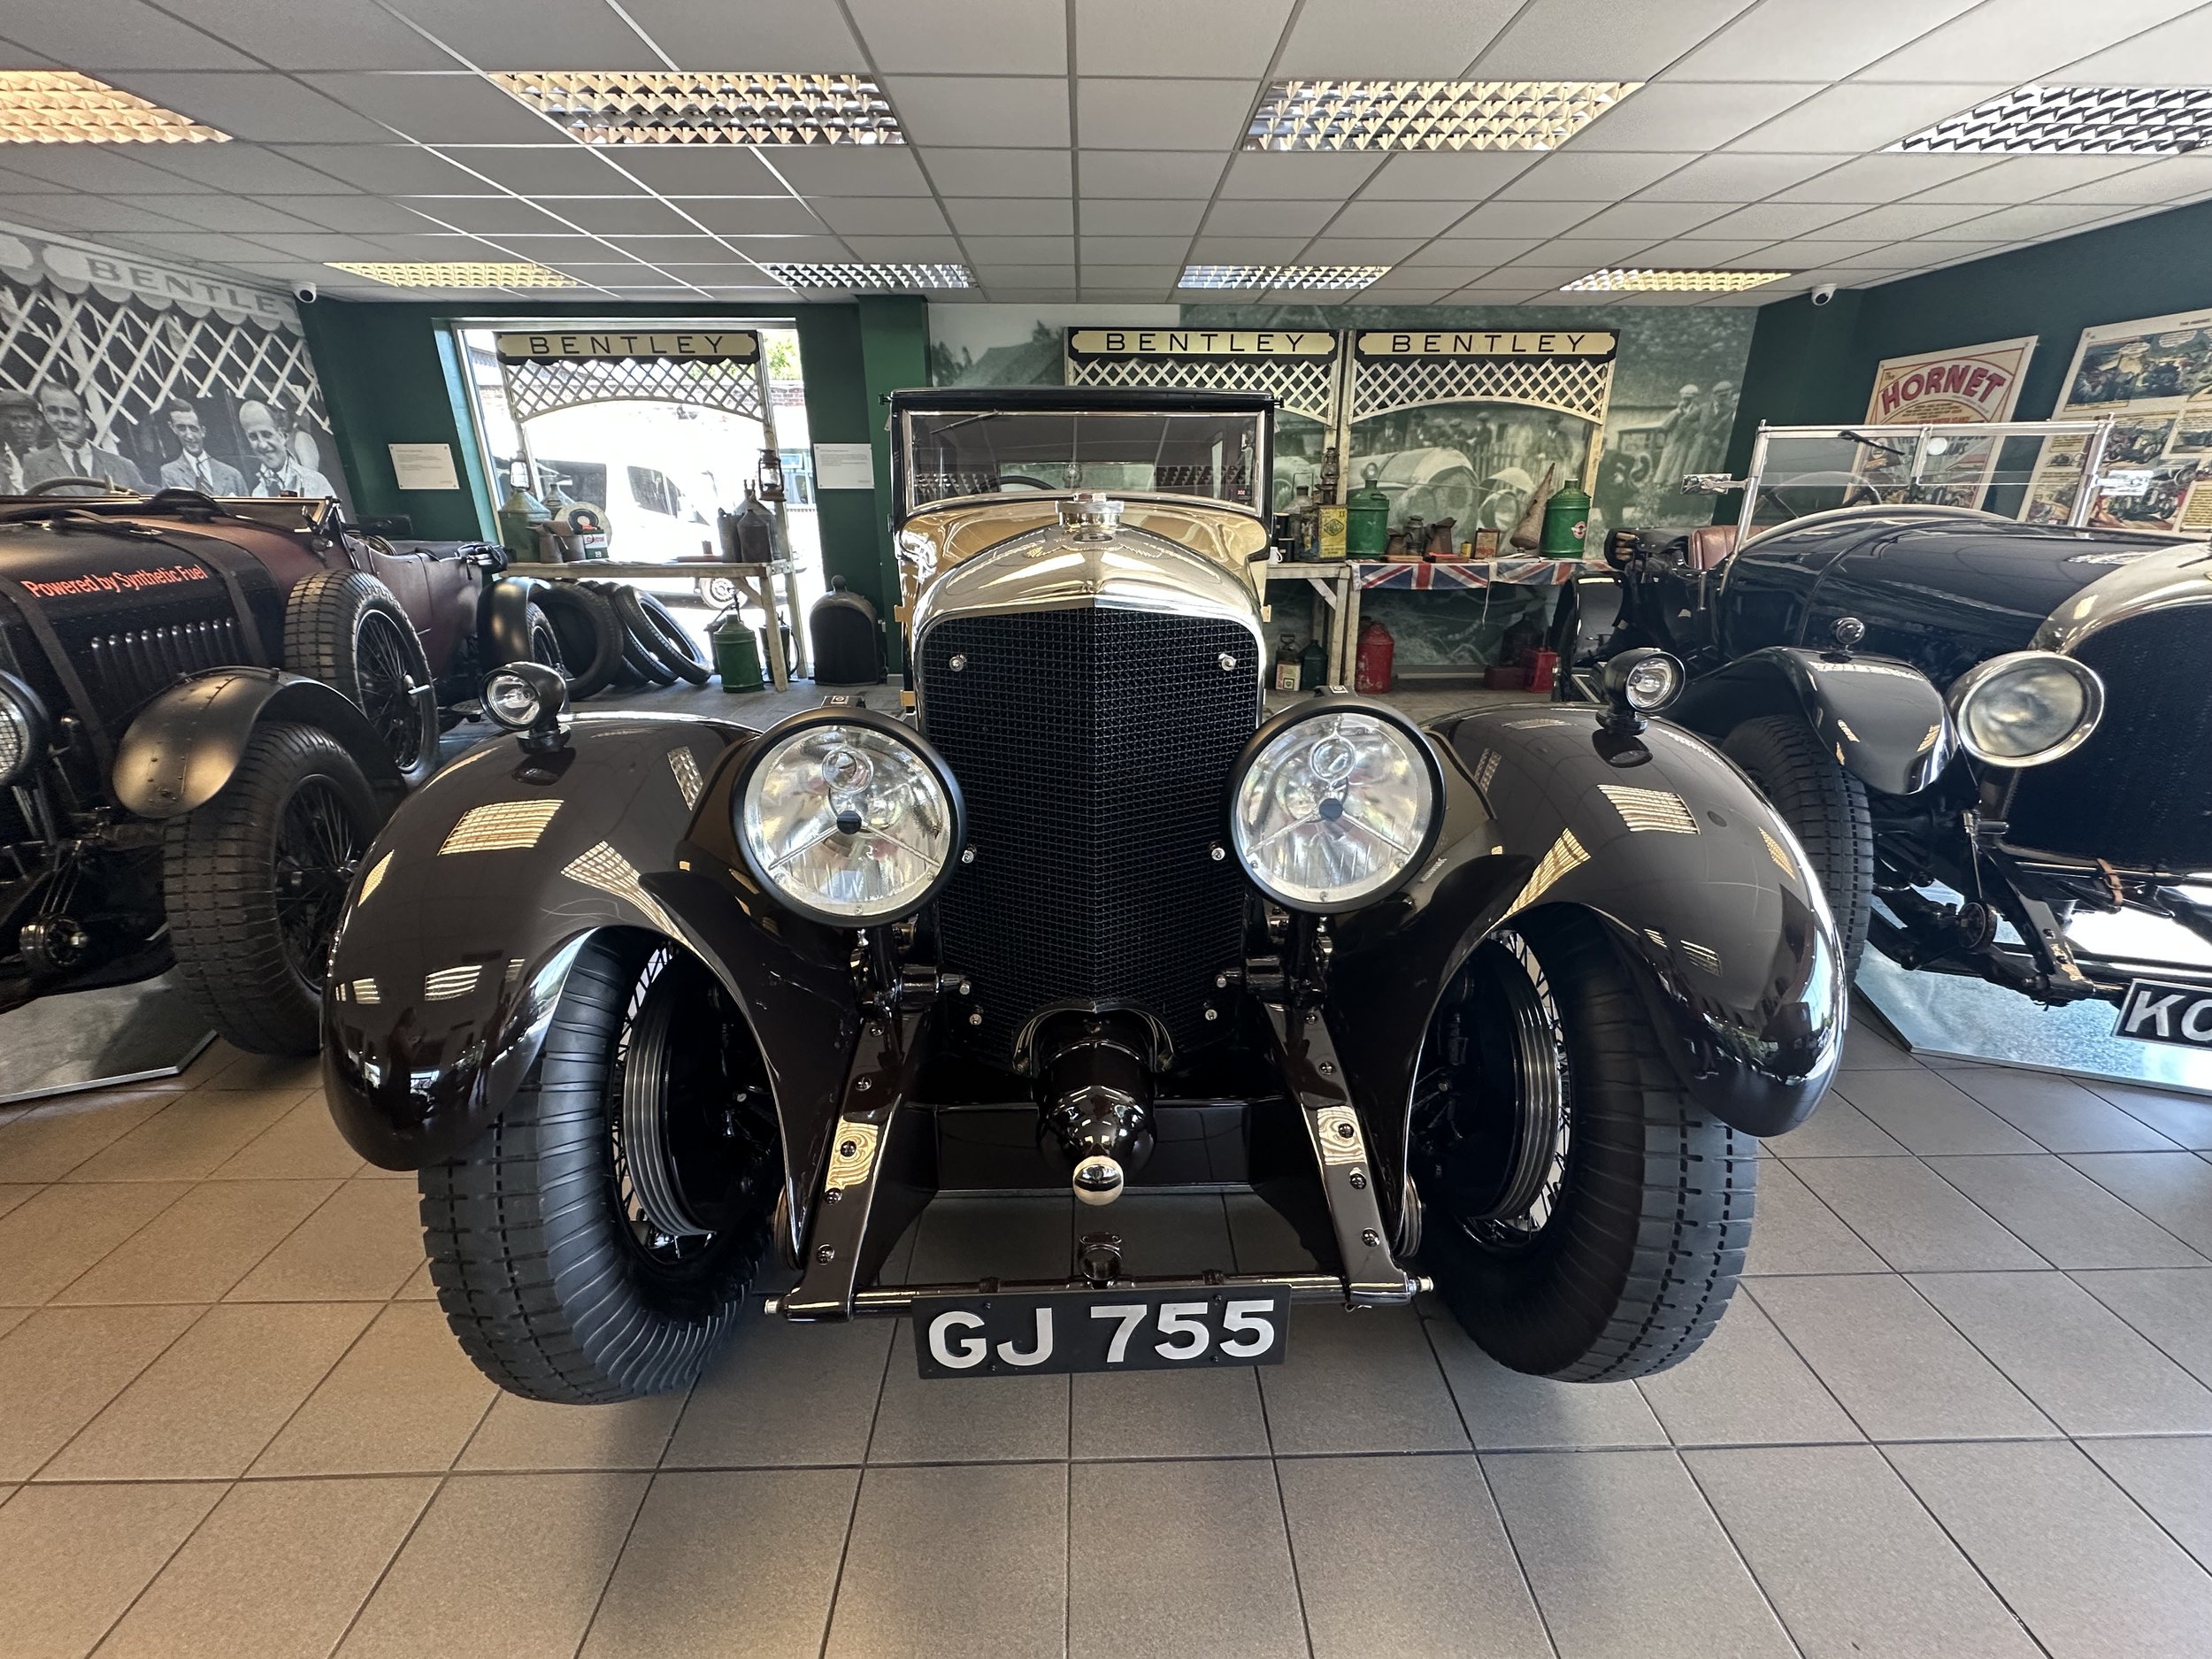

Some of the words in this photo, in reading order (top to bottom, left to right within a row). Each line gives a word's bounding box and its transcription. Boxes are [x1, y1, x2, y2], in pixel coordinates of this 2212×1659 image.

[528, 335, 724, 355] BENTLEY
[1106, 333, 1305, 352] BENTLEY
[1391, 334, 1586, 353] BENTLEY
[1881, 365, 2007, 416] HORNET
[19, 574, 101, 599] Powered
[93, 574, 121, 593] by
[112, 566, 182, 591] Synthetic
[174, 564, 209, 581] Fuel
[928, 1307, 1053, 1370] GJ
[1090, 1299, 1275, 1363] 755
